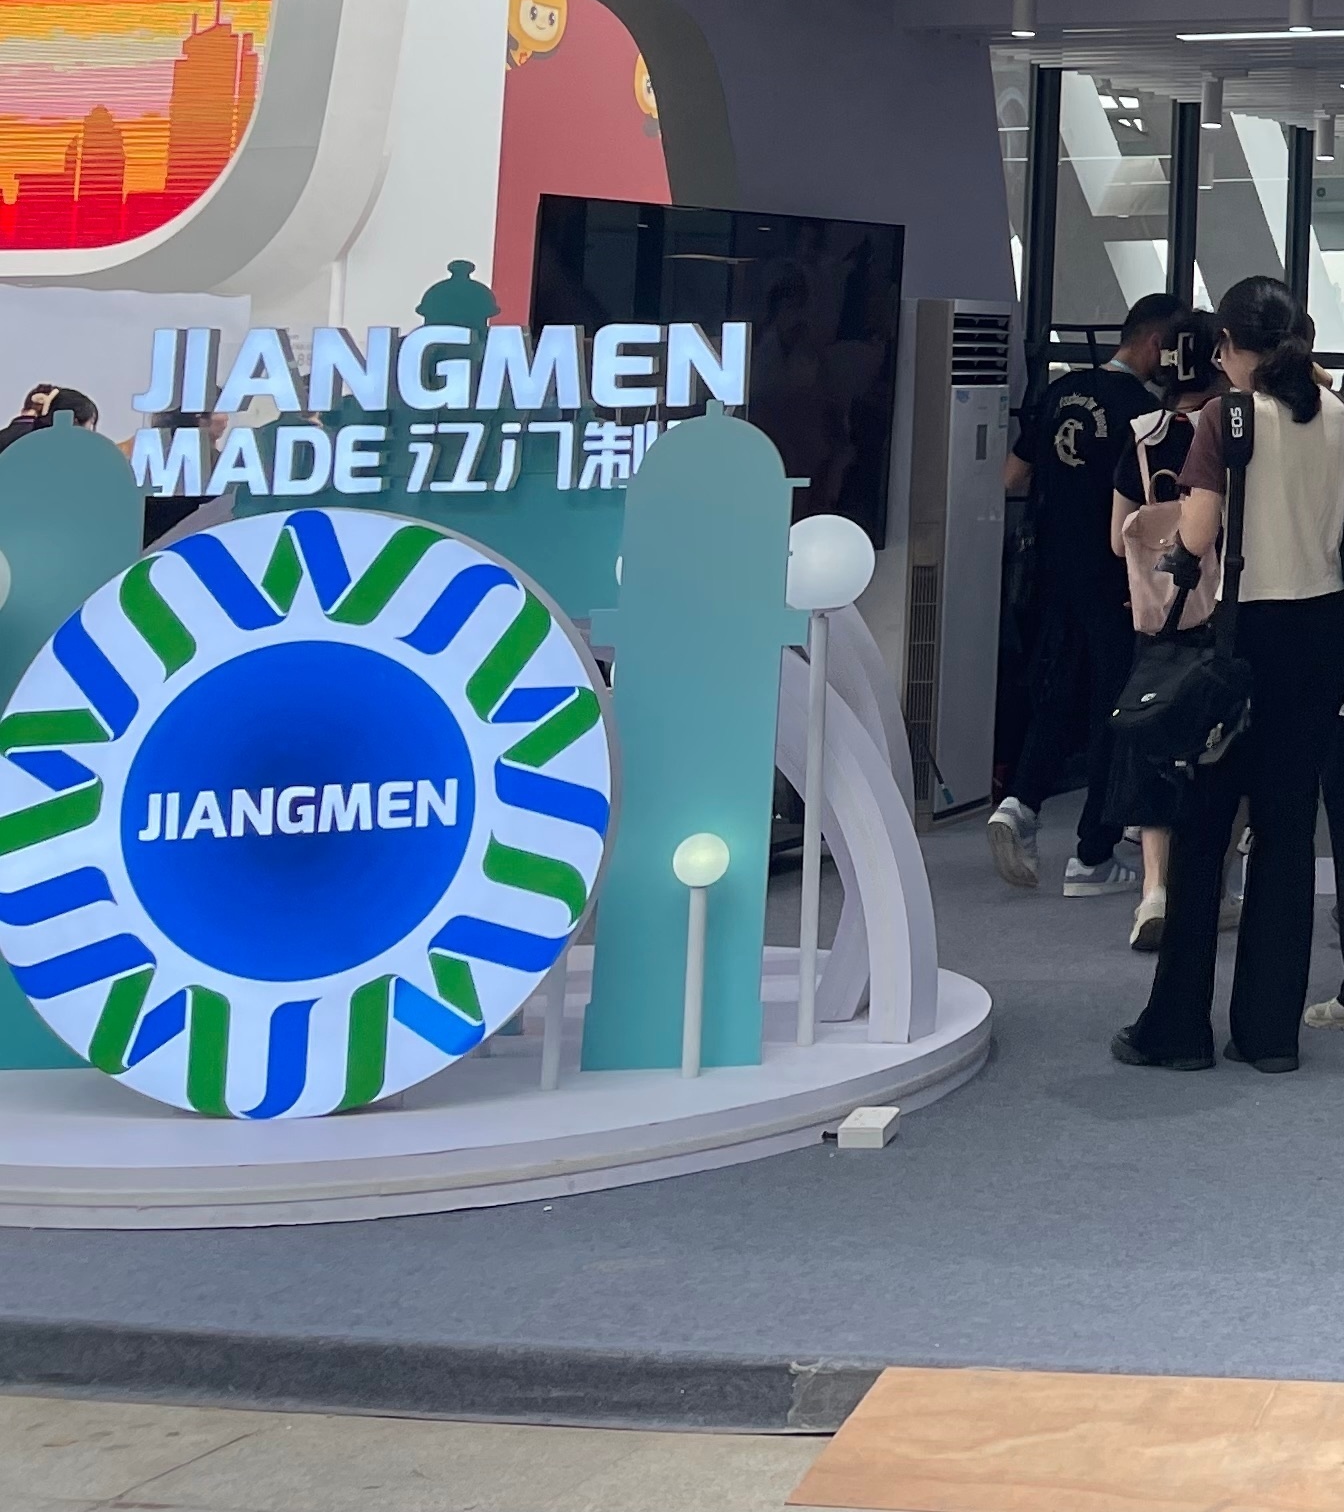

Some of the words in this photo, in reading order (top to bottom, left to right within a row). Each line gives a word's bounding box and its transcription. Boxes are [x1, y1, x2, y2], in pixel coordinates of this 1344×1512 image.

[131, 321, 749, 414] JIANGMEN
[407, 418, 683, 492] 江门制
[1230, 406, 1243, 438] EOS
[131, 424, 386, 497] MADE
[138, 778, 459, 842] JIANGMEN
